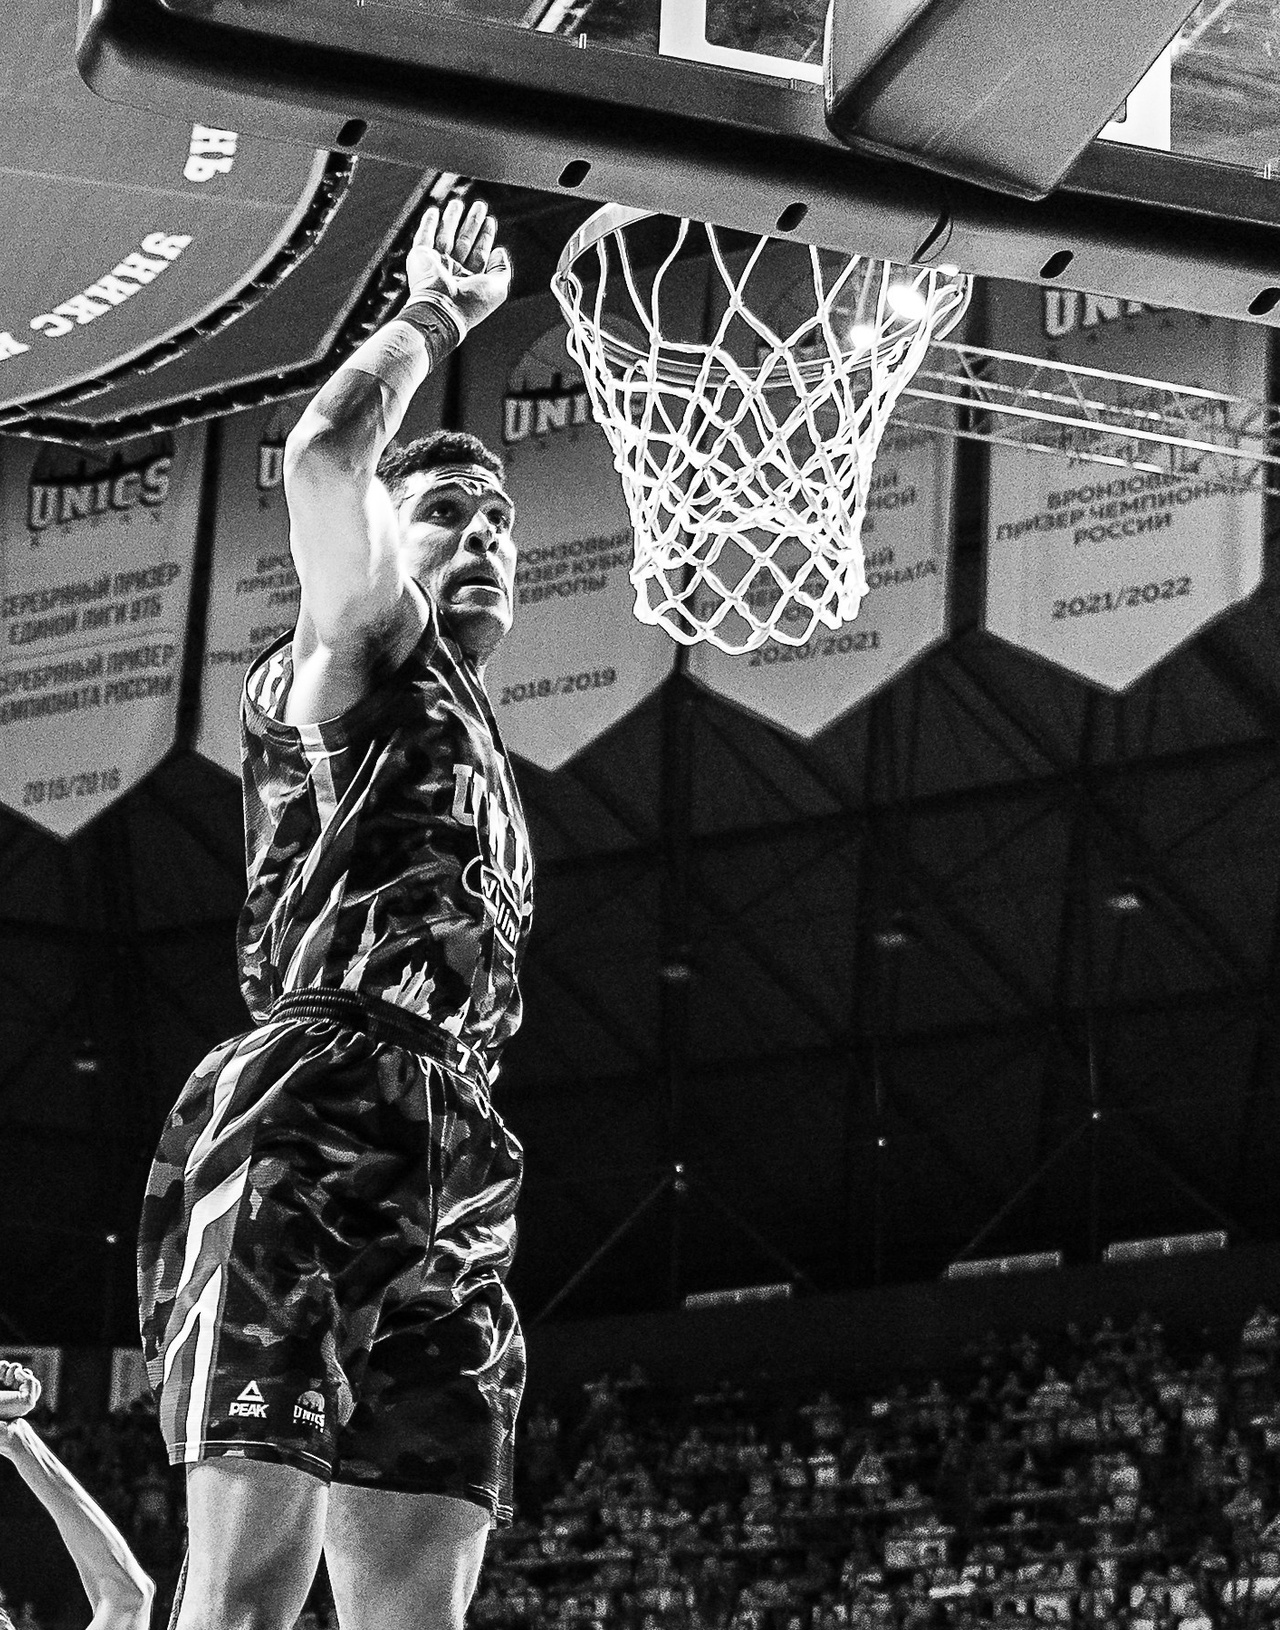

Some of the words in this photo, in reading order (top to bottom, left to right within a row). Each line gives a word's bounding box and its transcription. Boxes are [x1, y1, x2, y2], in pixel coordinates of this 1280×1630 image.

[29, 232, 192, 338] УНИКС
[29, 459, 172, 530] UNICS
[996, 509, 1085, 541] ПРИЗЕР
[1074, 512, 1172, 545] РОССИИ
[517, 529, 631, 565] РОНЗОВЫЙ
[516, 562, 569, 587] ИЗЕР
[1052, 577, 1193, 620] 2021/2022
[228, 1402, 270, 1419] PEAK
